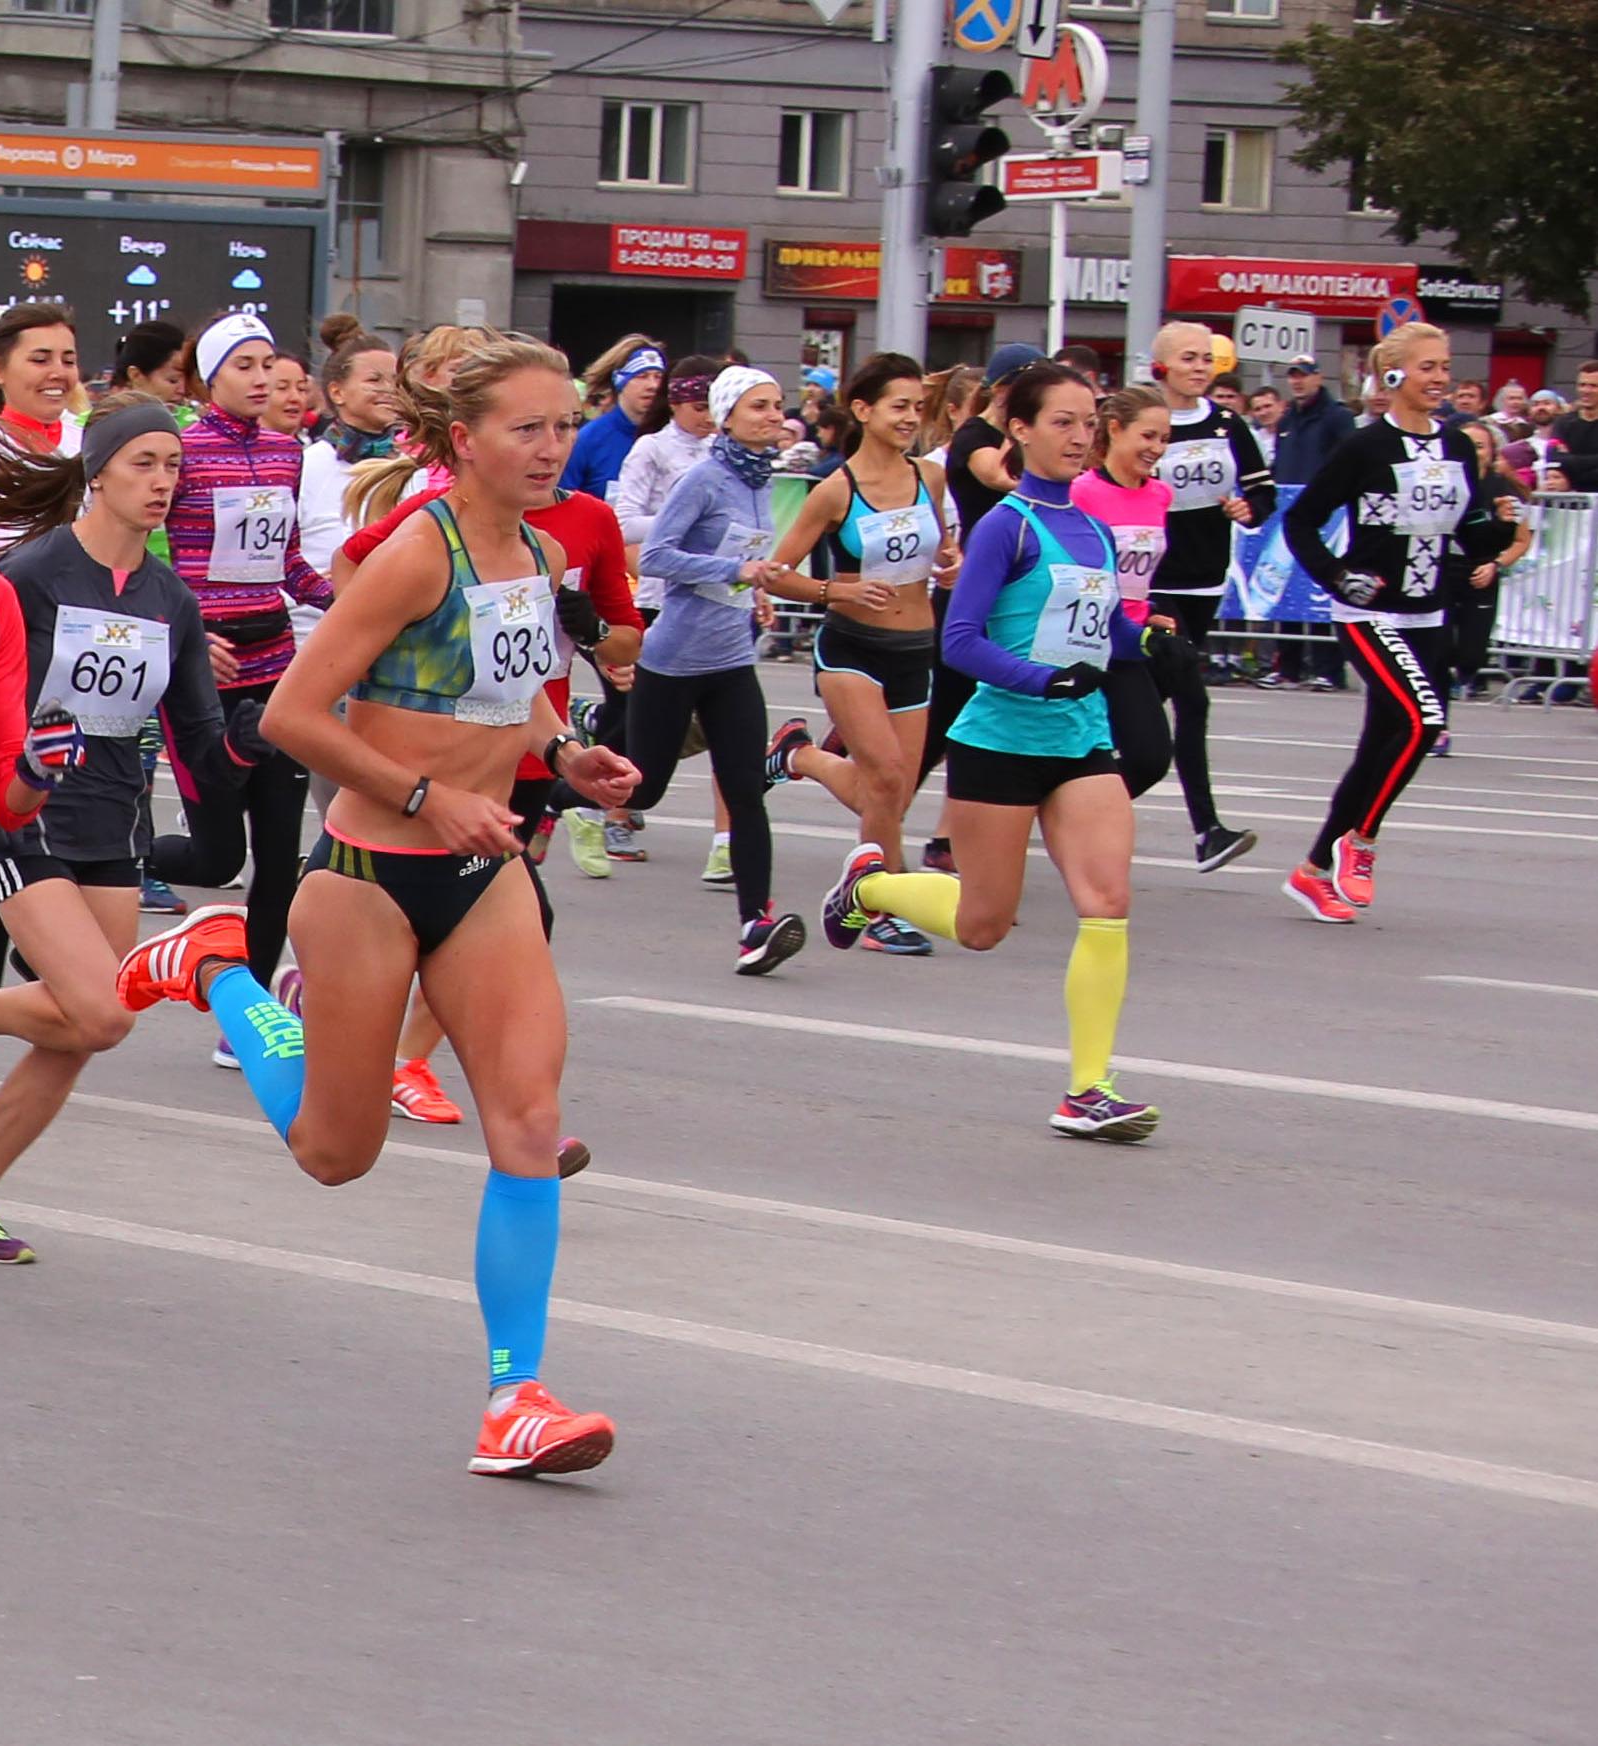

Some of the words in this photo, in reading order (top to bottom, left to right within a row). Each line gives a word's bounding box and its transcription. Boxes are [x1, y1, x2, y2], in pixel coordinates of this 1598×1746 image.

[88, 150, 136, 167] Метро
[8, 231, 64, 250] Сейчас
[119, 236, 167, 257] Вечер
[229, 241, 267, 259] Ночь
[618, 229, 685, 248] ПРОДАМ
[1217, 272, 1391, 298] ФАРМАКОПЕЙКА
[1241, 323, 1310, 351] СТОП
[1173, 461, 1224, 489] 943
[1411, 485, 1457, 511] 954
[235, 517, 287, 550] 134
[886, 532, 920, 564] 82
[492, 625, 552, 683] 933
[71, 650, 148, 702] 661
